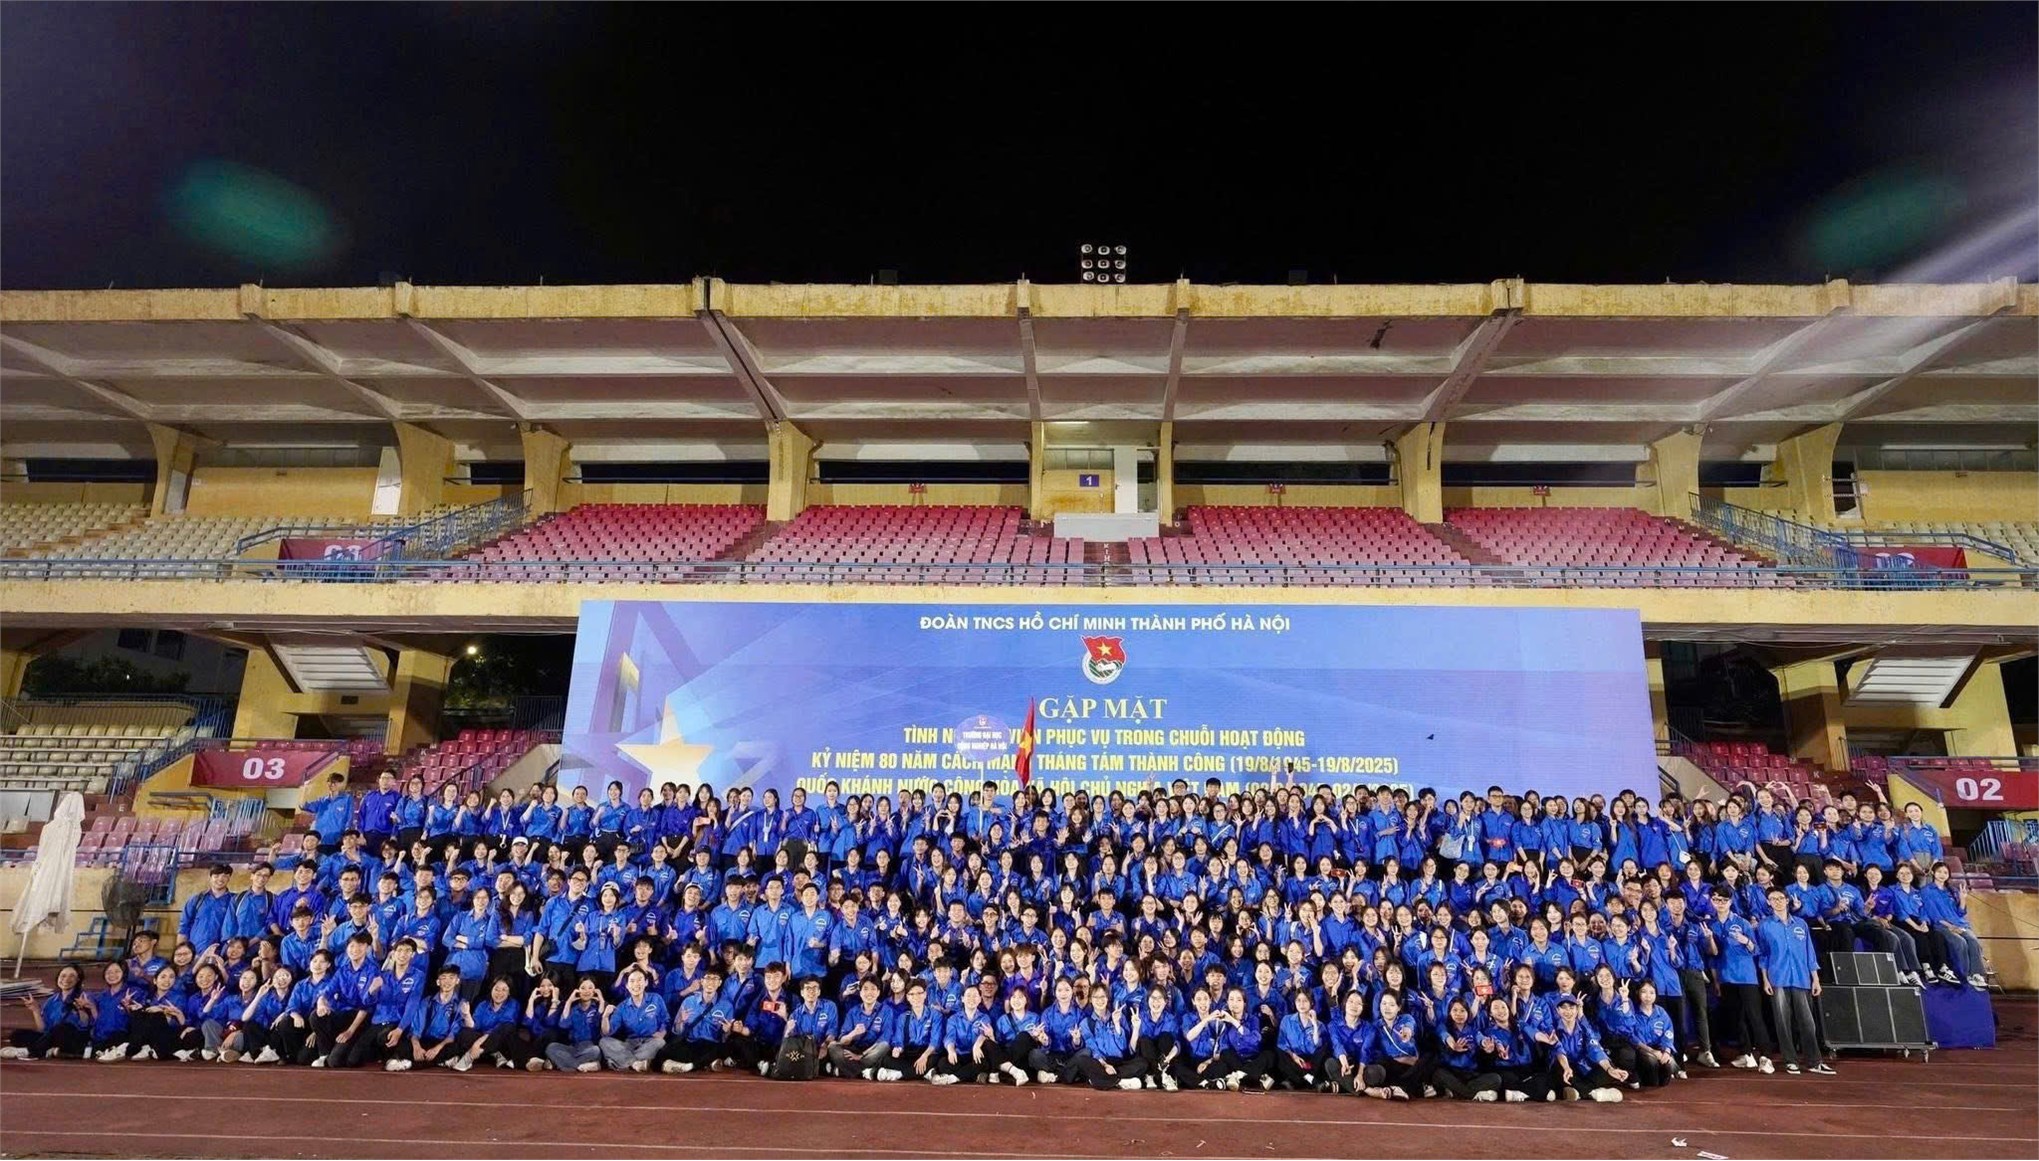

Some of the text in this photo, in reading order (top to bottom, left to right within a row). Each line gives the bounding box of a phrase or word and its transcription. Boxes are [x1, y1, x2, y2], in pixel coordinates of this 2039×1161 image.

[1086, 476, 1092, 486] 1
[920, 611, 1290, 634] ĐOÀN TNCS HỒ CHÍ MINH THÀNH PHỐ HÀ NỘI
[1039, 695, 1168, 725] GẶP MẶT
[904, 724, 938, 744] TÌNH
[1046, 728, 1086, 748] PHỤC
[1091, 729, 1110, 749] VỤ
[1115, 729, 1165, 746] TRONG
[1169, 724, 1215, 747] CHUỖI
[1219, 730, 1258, 750] HOẠT
[1263, 726, 1305, 750] ĐỘNG
[242, 757, 285, 779] 03
[811, 747, 832, 768] KỶ
[835, 750, 874, 772] NIỆM
[879, 752, 898, 769] 80
[901, 749, 937, 769] NĂM
[1037, 752, 1086, 770] THÁNG
[1091, 752, 1124, 771] TÁM
[1129, 751, 1178, 771] THÀNH
[1183, 752, 1225, 772] CÔNG
[841, 775, 893, 794] KHÁNH
[1956, 777, 2004, 801] 02
